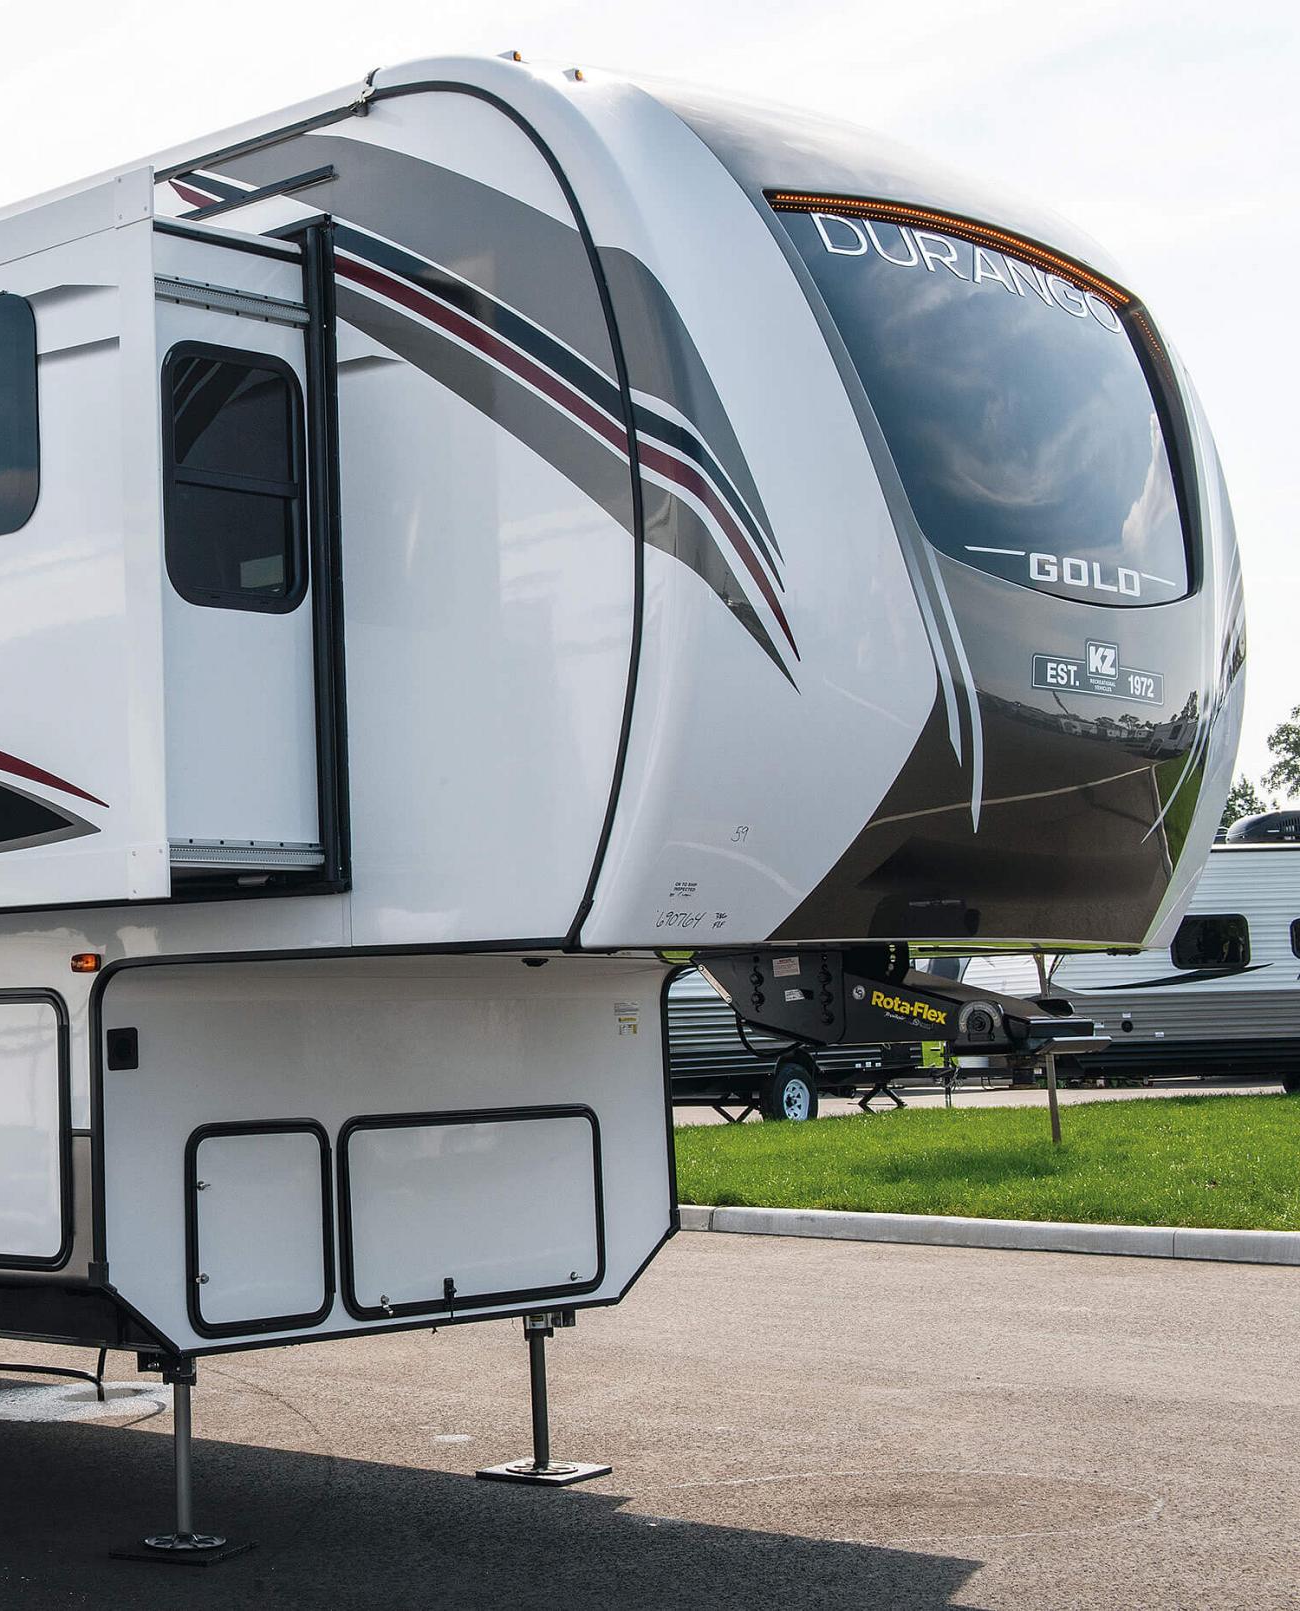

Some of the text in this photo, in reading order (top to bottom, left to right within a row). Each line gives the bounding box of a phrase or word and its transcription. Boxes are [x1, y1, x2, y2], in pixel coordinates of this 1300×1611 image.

[810, 211, 1122, 335] DURANGO
[1029, 552, 1141, 597] GOLD
[1088, 645, 1116, 676] KZ
[1046, 662, 1155, 698] EST. 1972
[731, 826, 749, 842] 59
